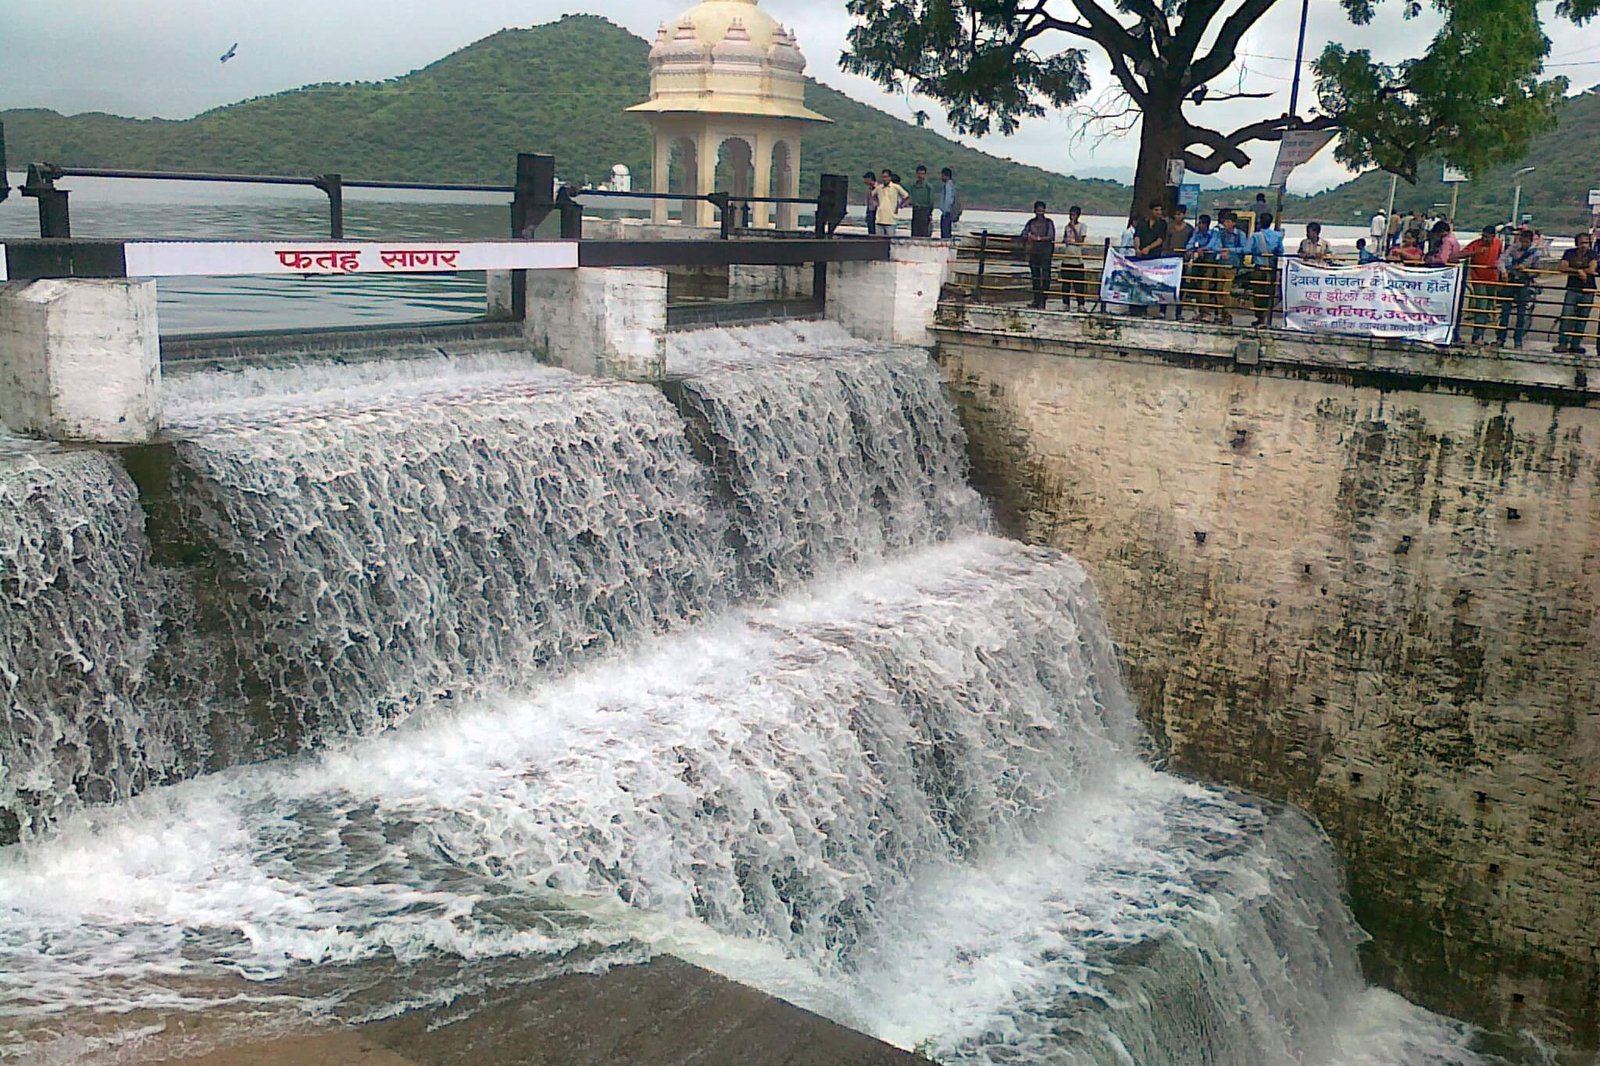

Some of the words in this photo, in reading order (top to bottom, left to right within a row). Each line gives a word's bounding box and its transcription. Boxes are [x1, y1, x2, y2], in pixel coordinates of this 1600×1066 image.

[274, 250, 361, 271] फतह
[380, 250, 460, 268] सागर
[1290, 274, 1320, 286] देवास
[1324, 274, 1365, 287] योजना
[1369, 275, 1381, 287] के
[1426, 280, 1451, 293] होने
